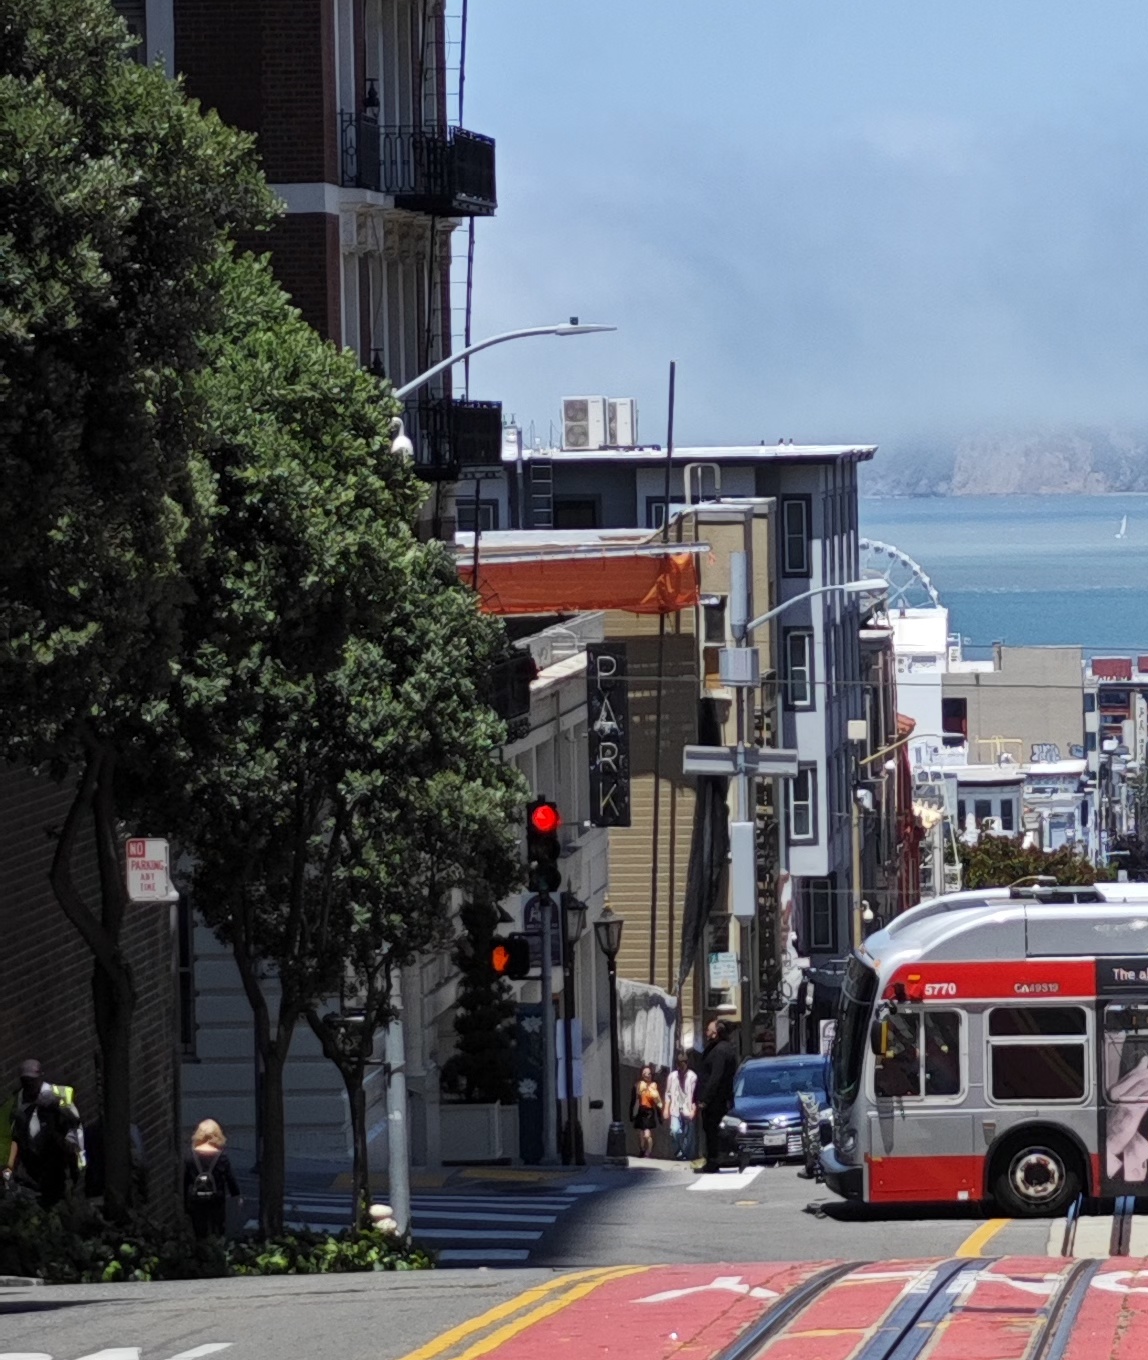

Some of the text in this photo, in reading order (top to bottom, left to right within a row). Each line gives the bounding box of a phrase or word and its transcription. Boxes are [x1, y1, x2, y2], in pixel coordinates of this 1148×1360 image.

[597, 655, 620, 817] PARK
[130, 842, 144, 856] NO
[131, 860, 164, 871] PARKING
[1113, 968, 1135, 981] The
[924, 982, 957, 995] 5770
